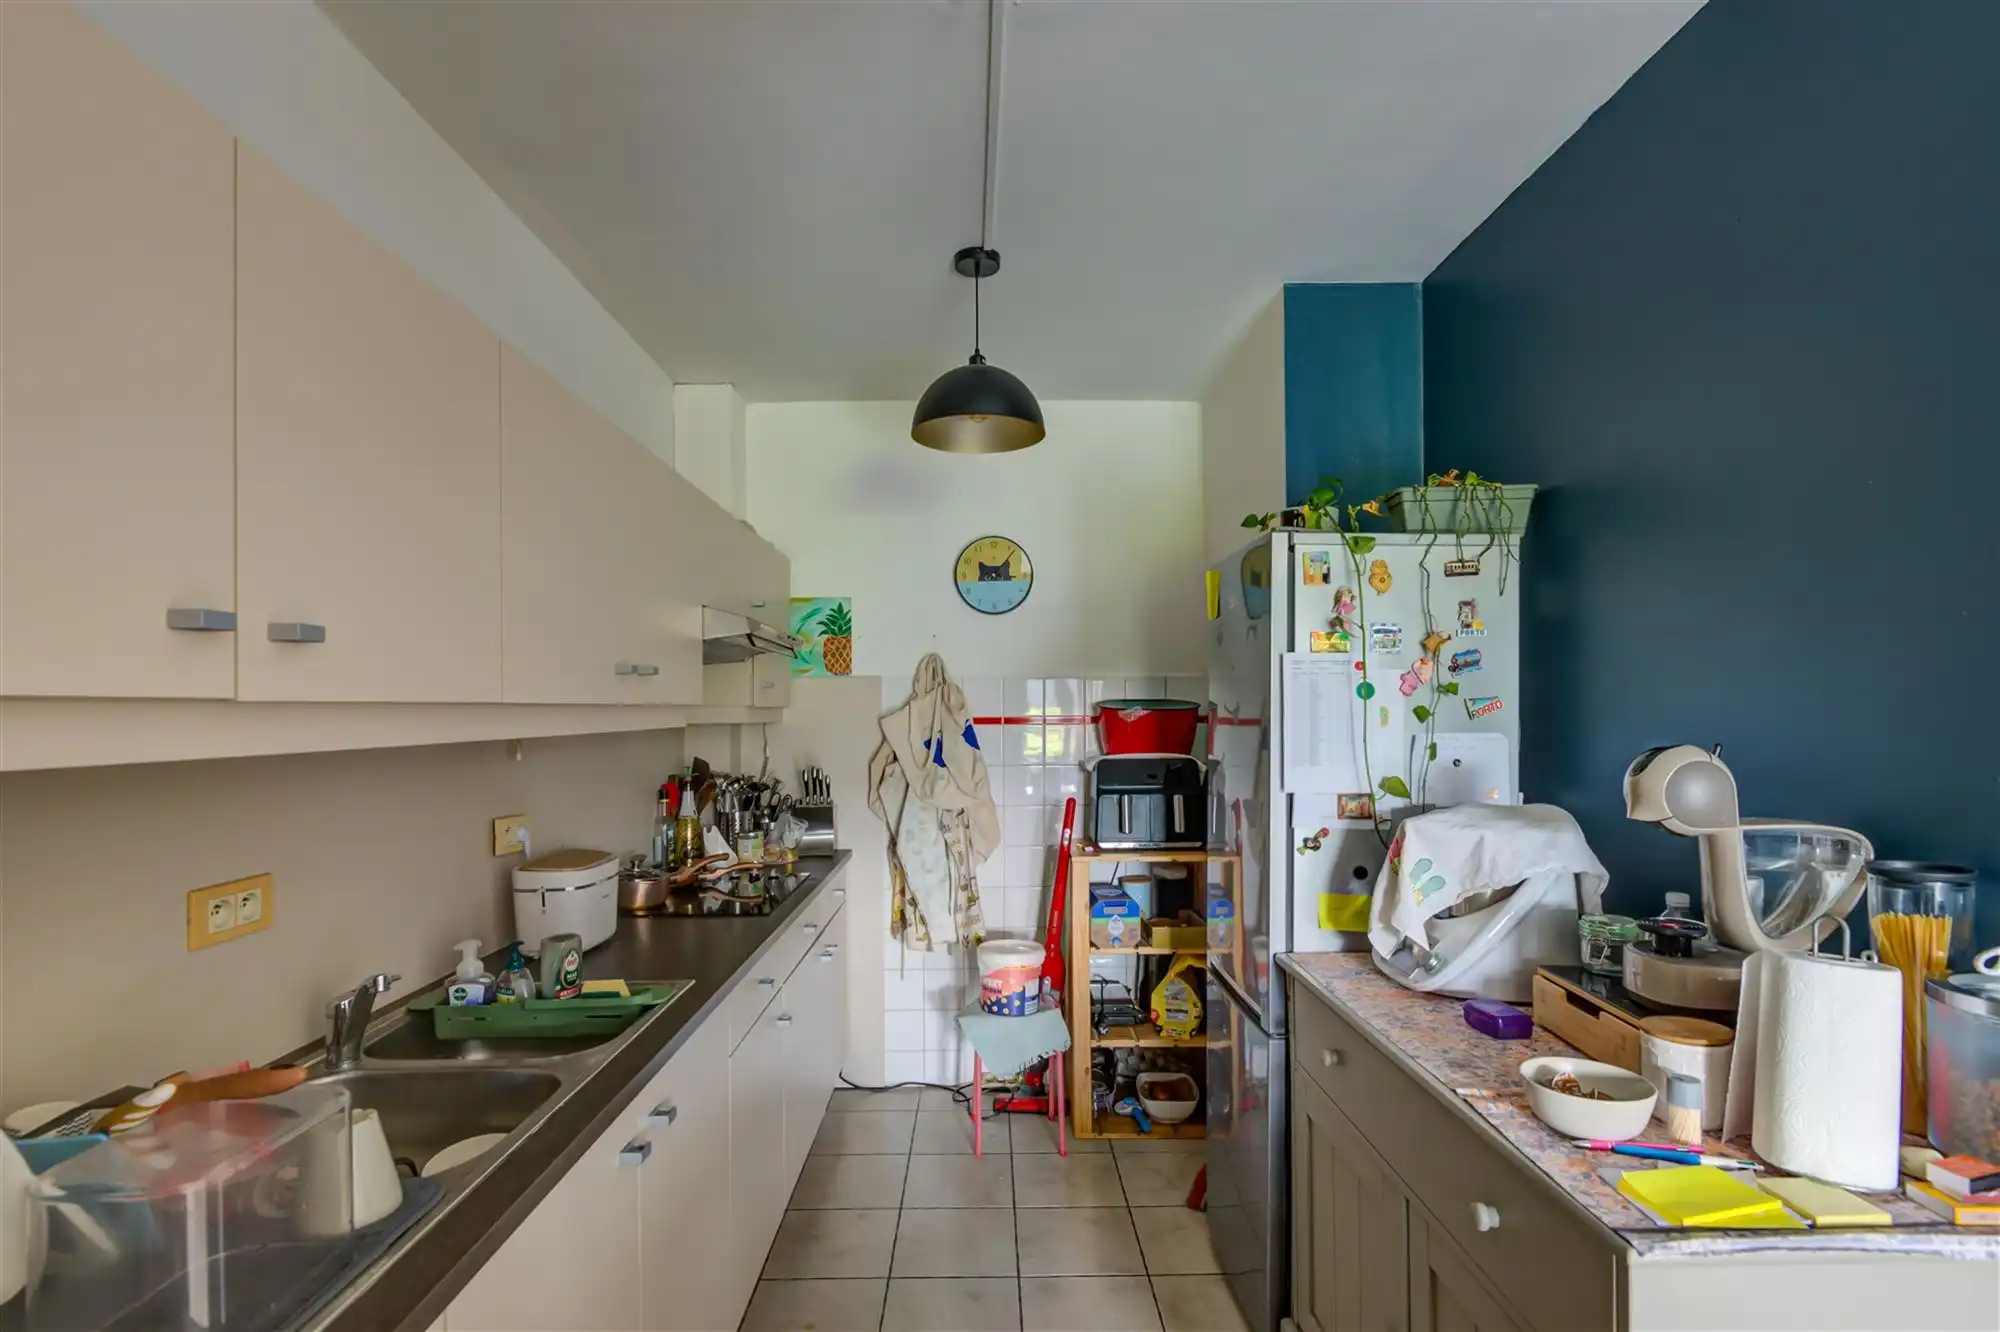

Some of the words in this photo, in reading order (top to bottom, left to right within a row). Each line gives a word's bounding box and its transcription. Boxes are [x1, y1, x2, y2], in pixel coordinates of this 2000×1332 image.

[974, 545, 982, 553] 11
[989, 541, 998, 549] 12
[1471, 700, 1503, 719] PORTO
